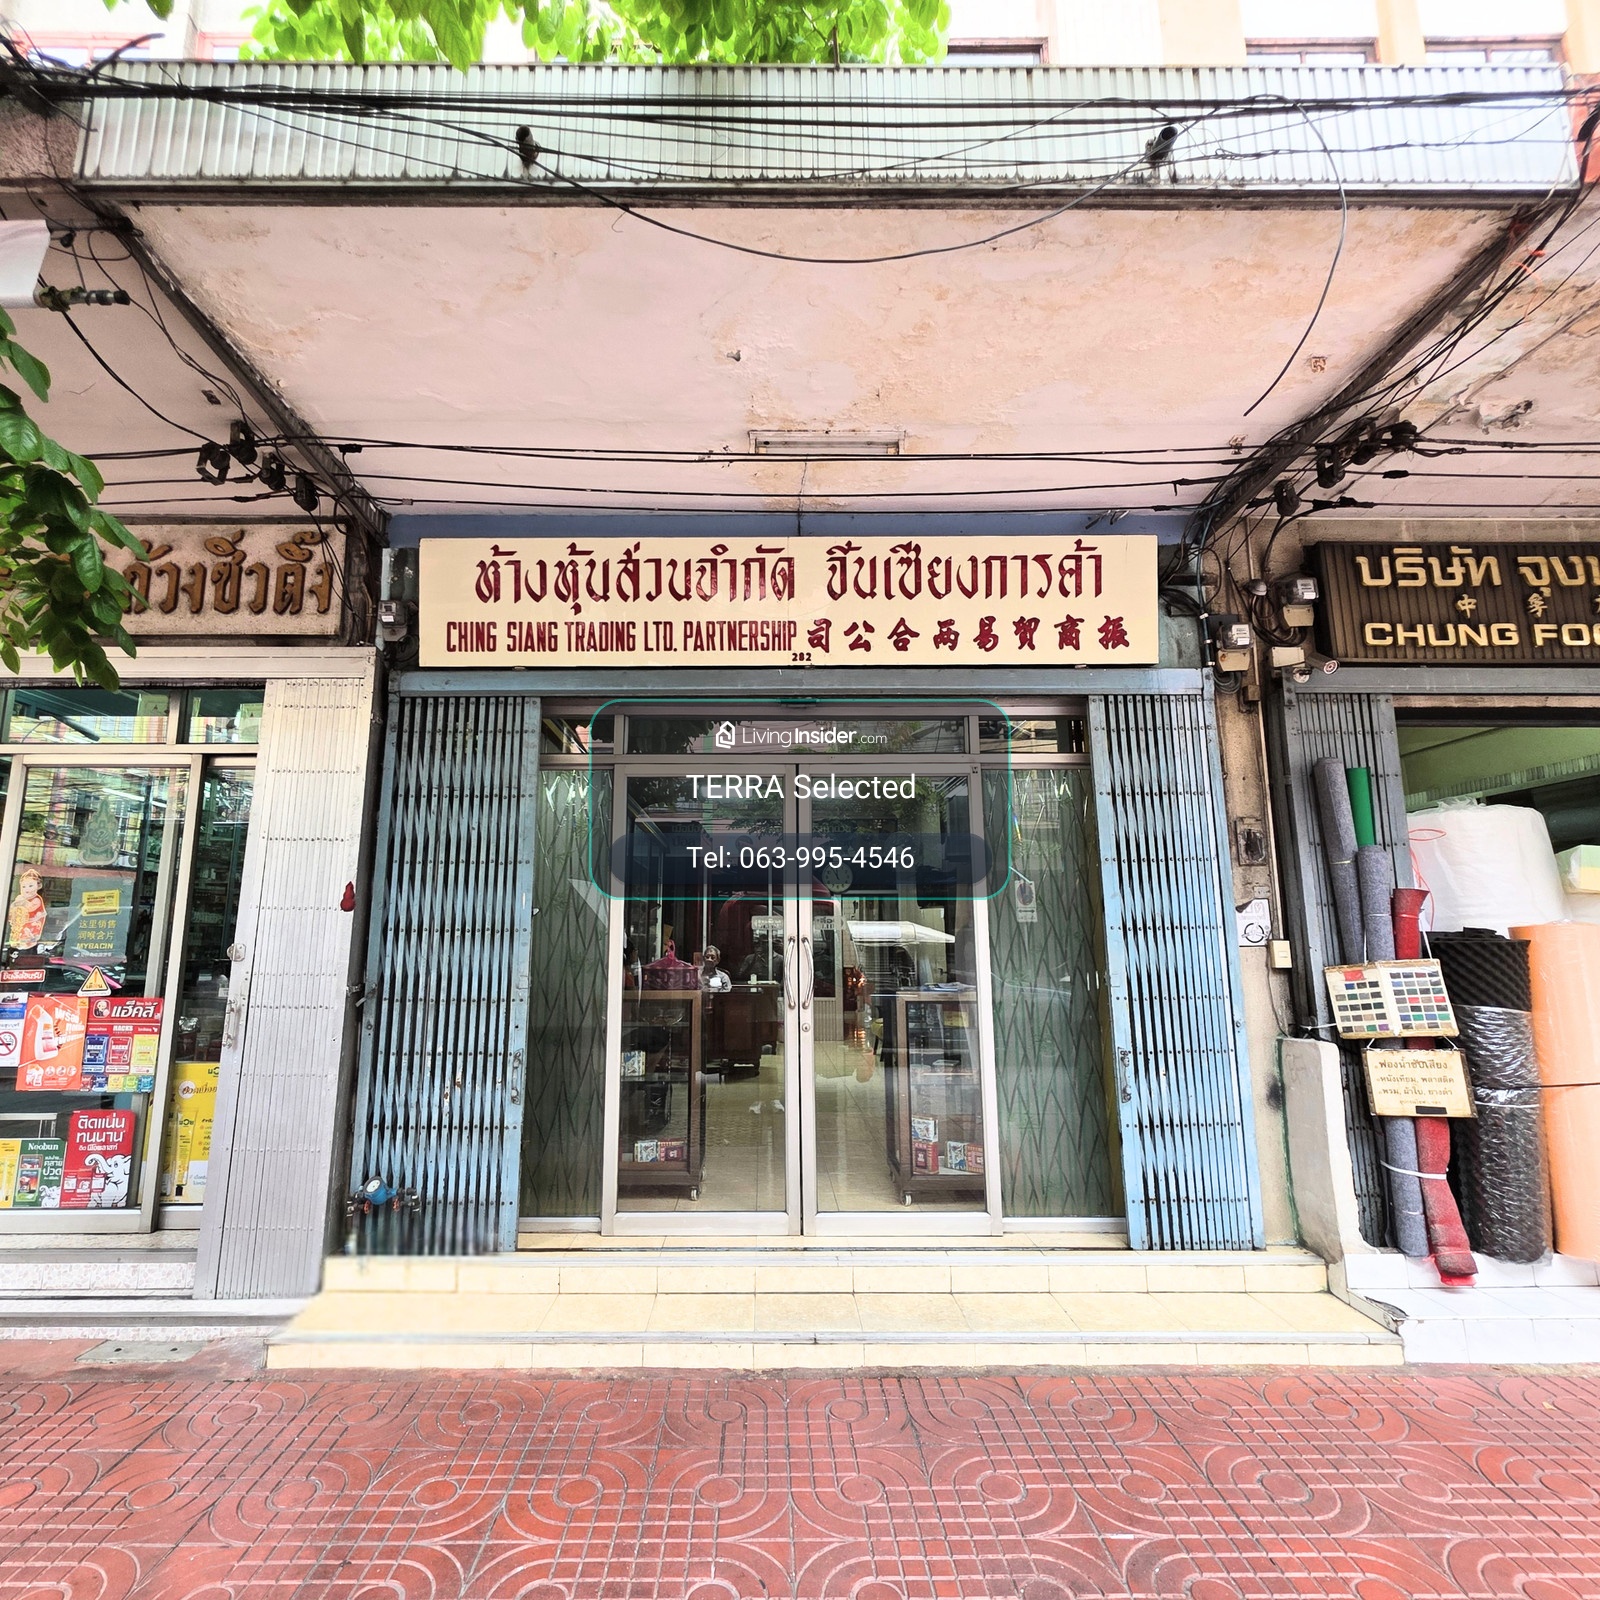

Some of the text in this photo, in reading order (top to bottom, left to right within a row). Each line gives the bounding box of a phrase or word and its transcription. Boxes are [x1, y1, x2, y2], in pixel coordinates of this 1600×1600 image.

[475, 541, 796, 616] ห้างหุ้นส่วนจำกัด
[1355, 546, 1503, 588] บริษัท
[446, 620, 797, 653] CHING SIANG TRADING LTD. PARTNERSHIP
[1364, 622, 1520, 647] CHUNG
[791, 652, 813, 662] 282
[76, 942, 114, 950] MYBACIN
[78, 1112, 126, 1130] ติดแน่น
